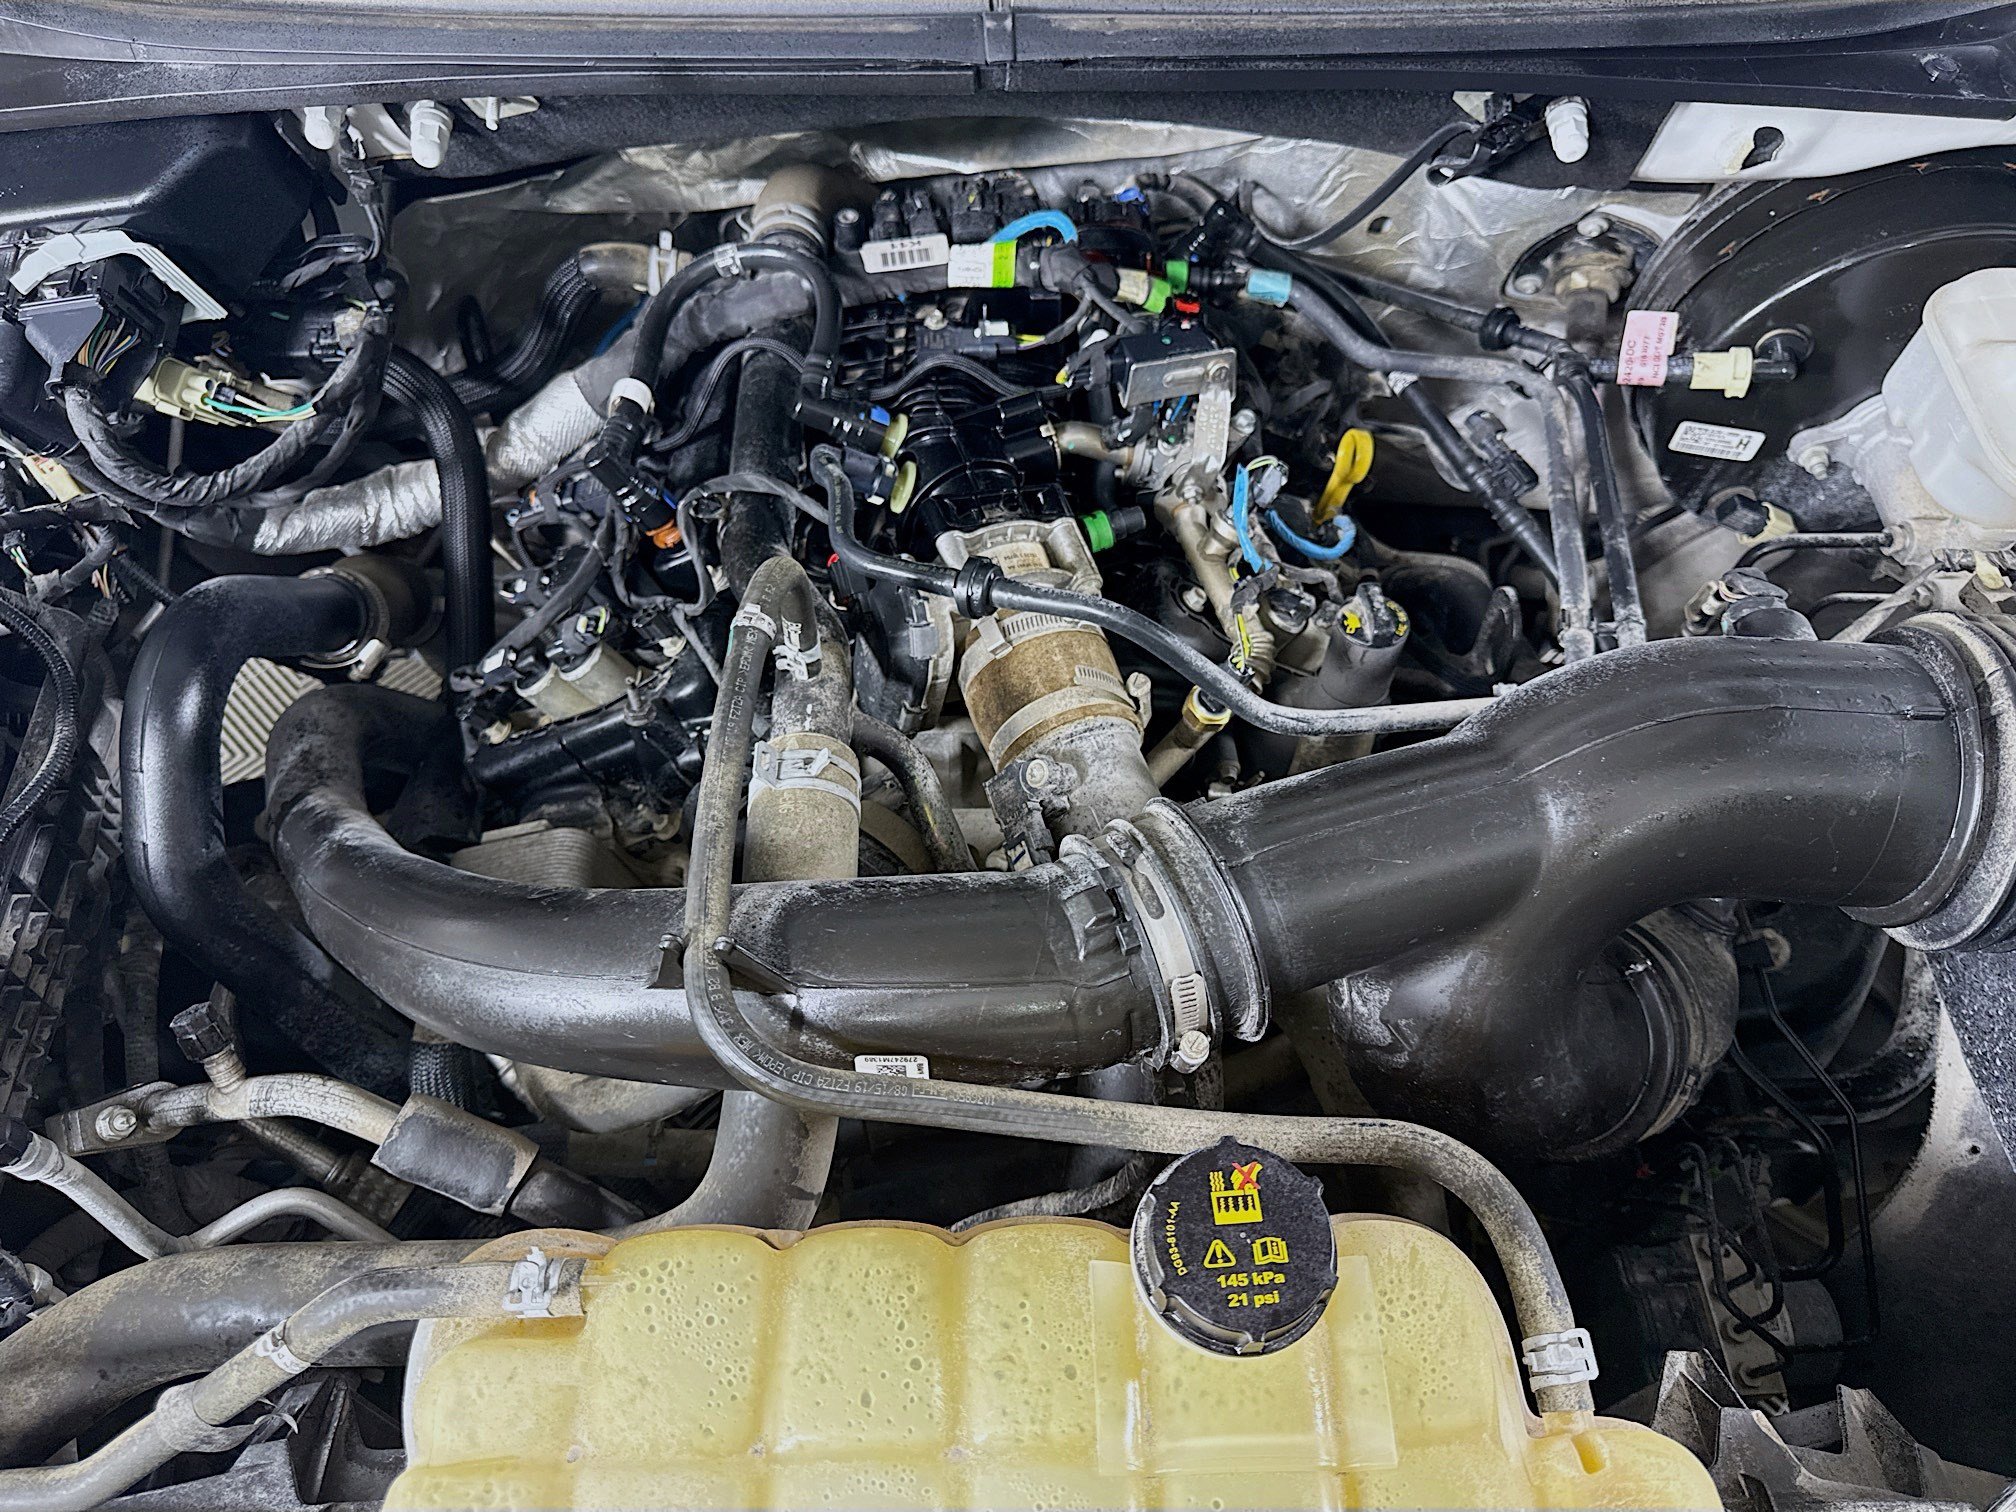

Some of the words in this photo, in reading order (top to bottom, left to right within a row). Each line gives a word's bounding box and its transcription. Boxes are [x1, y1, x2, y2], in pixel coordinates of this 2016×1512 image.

[733, 1032, 755, 1053] MEX
[790, 1070, 813, 1084] CIP
[1216, 1272, 1249, 1289] 145
[1252, 1271, 1286, 1287] kPa
[1227, 1293, 1249, 1307] 21
[1253, 1290, 1280, 1308] psi
